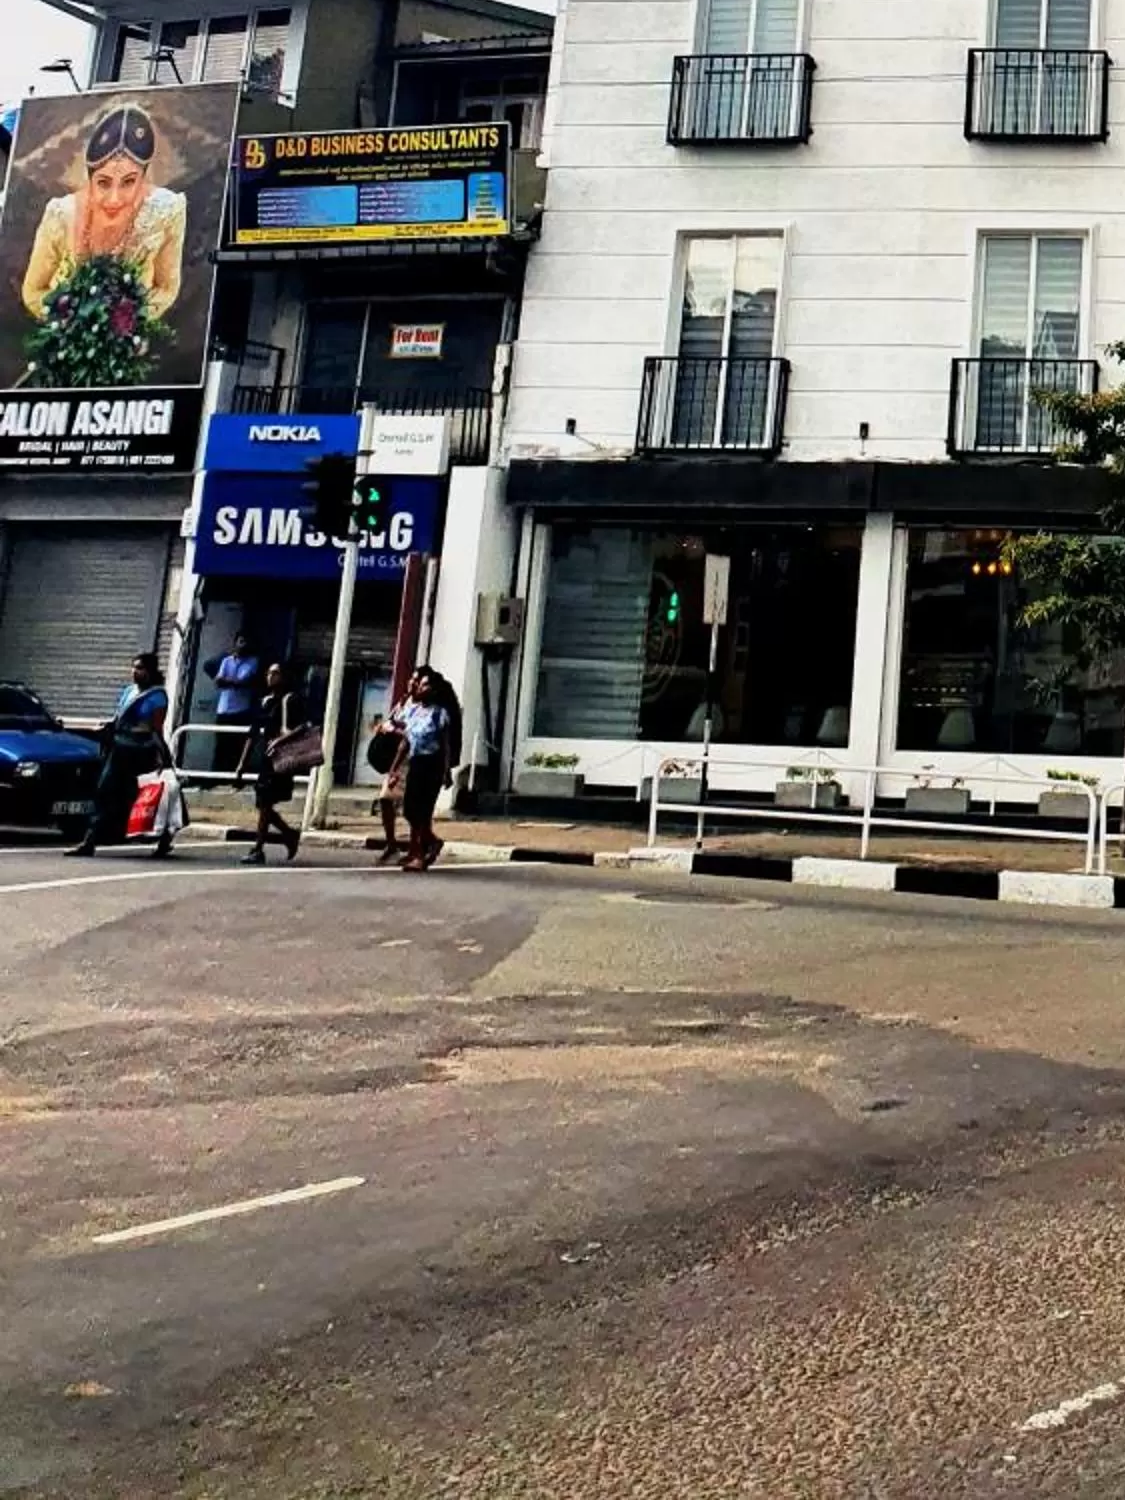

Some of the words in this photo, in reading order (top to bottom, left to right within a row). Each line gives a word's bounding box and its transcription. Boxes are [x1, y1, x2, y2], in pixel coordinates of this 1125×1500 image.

[275, 137, 307, 158] D&D
[311, 133, 385, 156] BUSINESS
[388, 127, 500, 151] CONSULTANTS
[0, 401, 70, 437] ALON
[71, 399, 175, 435] ASANGI
[249, 425, 321, 441] NOKIA
[19, 441, 53, 452] BRIDAL
[92, 440, 131, 452] BEAUTY
[213, 505, 414, 551] SAMG
